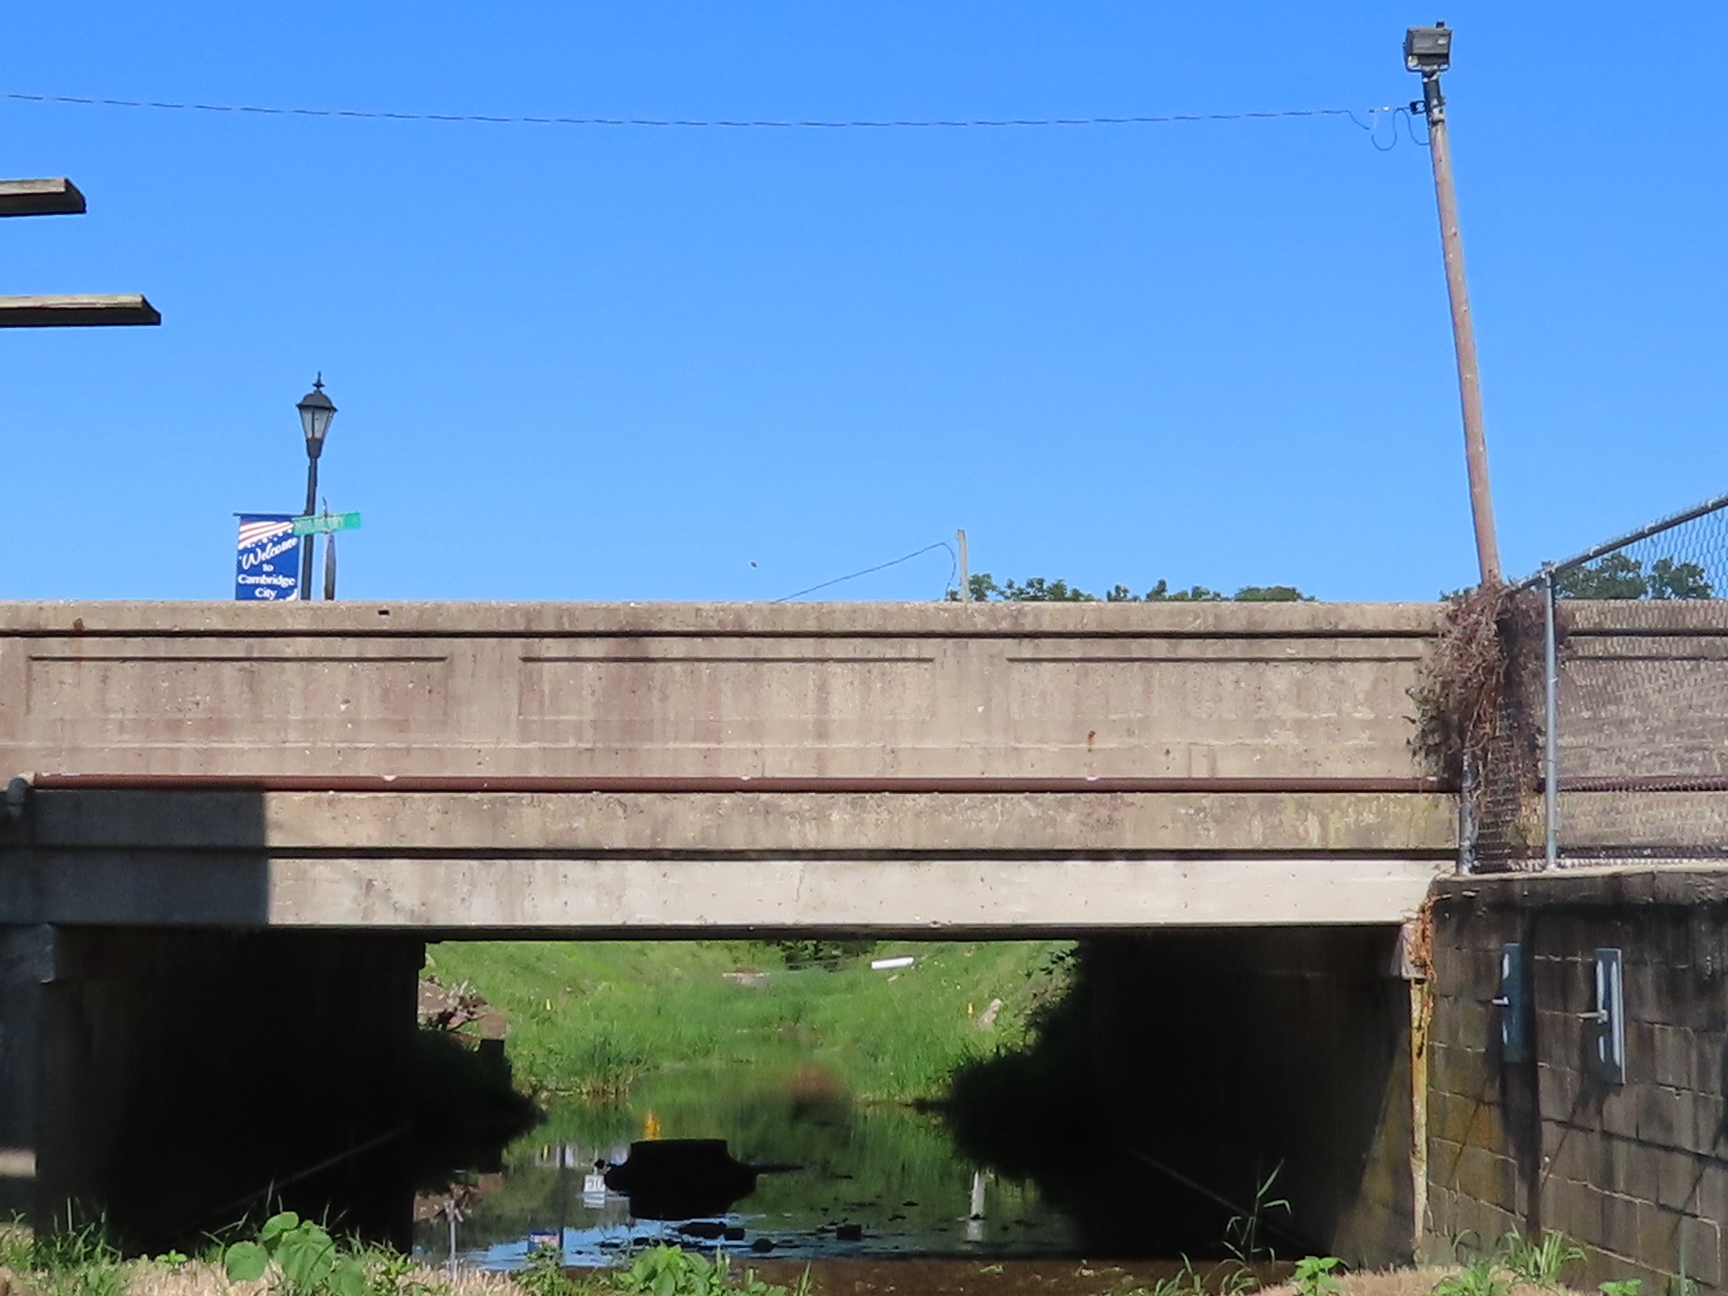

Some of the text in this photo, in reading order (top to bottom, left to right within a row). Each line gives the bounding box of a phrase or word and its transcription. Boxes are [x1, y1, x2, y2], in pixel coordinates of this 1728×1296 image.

[242, 537, 298, 570] Welcome
[262, 564, 274, 572] to
[237, 574, 296, 588] Cambridge
[254, 587, 278, 600] City
